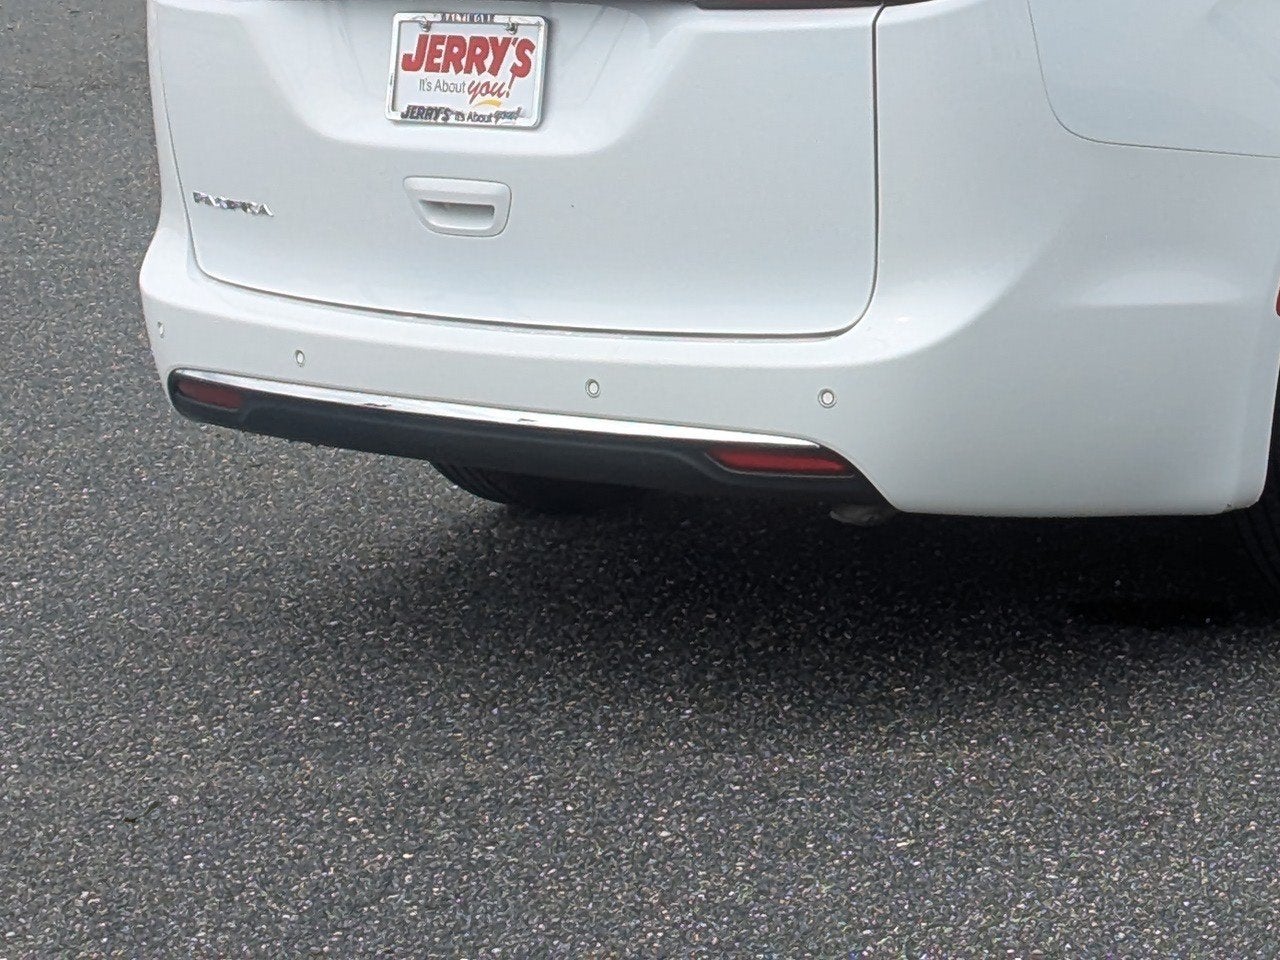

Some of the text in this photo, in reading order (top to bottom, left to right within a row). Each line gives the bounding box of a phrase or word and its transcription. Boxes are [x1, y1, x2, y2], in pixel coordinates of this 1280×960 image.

[401, 33, 536, 79] JERRY'S
[419, 77, 515, 104] It's About you!
[400, 104, 451, 122] JERRY'S
[466, 111, 493, 123] About
